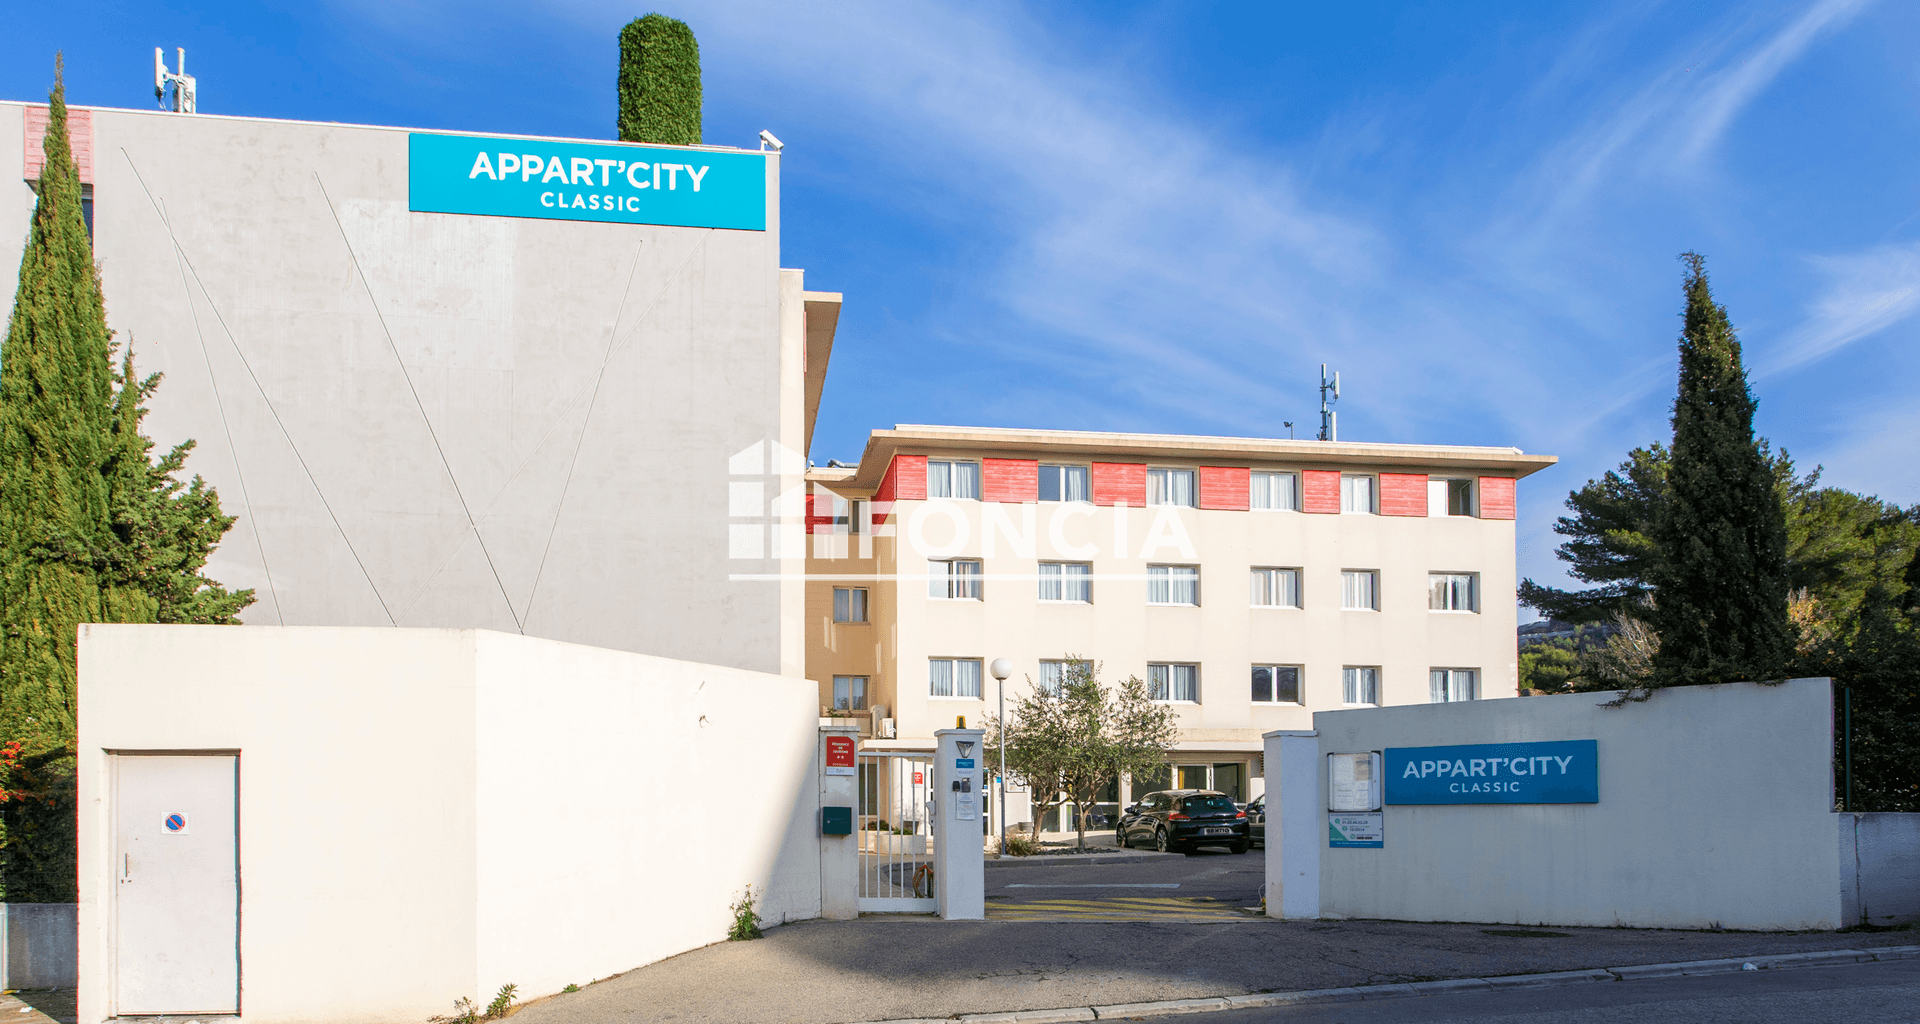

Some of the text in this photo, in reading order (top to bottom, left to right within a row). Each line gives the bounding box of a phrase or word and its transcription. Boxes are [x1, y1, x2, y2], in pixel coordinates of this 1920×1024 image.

[469, 151, 710, 193] APPART'CITY
[540, 191, 641, 213] CLASSIC
[1402, 755, 1574, 779] APPART'CITY
[1449, 781, 1521, 793] CLASSIC
